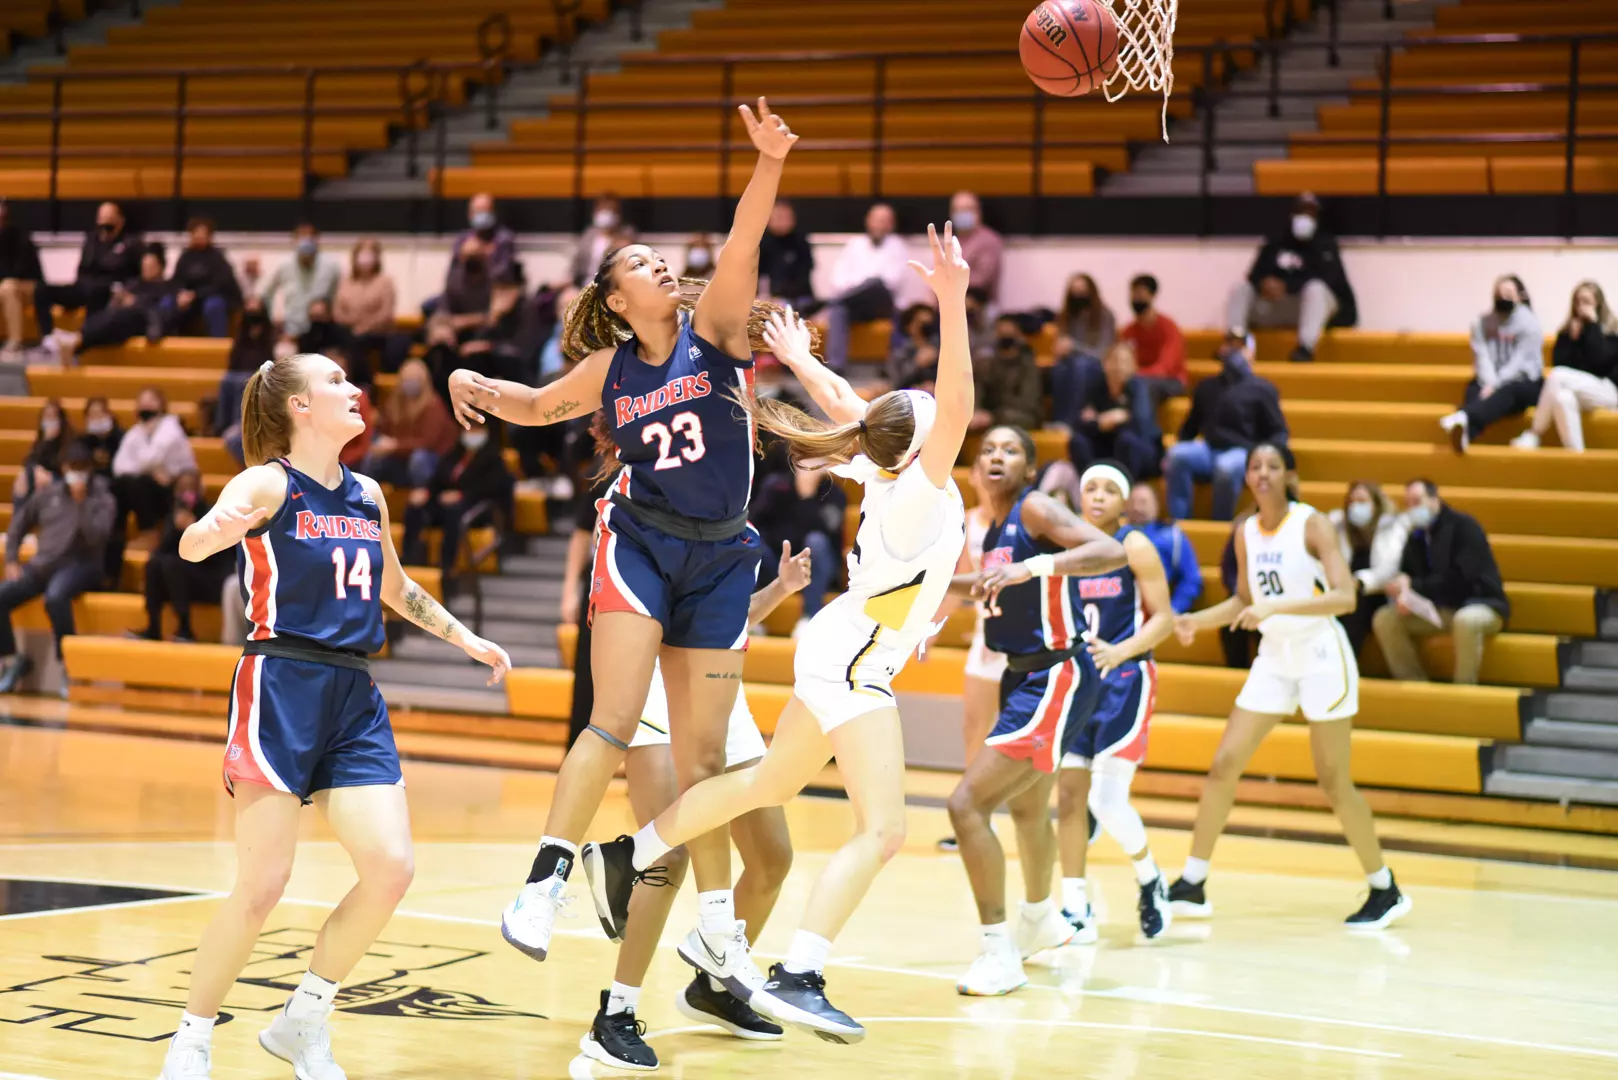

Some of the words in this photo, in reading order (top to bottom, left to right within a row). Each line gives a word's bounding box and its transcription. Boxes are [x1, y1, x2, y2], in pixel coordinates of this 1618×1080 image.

[1033, 4, 1067, 48] Wilso
[614, 371, 712, 428] RAIDERS
[641, 411, 706, 471] 23
[295, 510, 381, 541] RAIDERS
[331, 546, 373, 600] 14
[1256, 570, 1284, 596] 20
